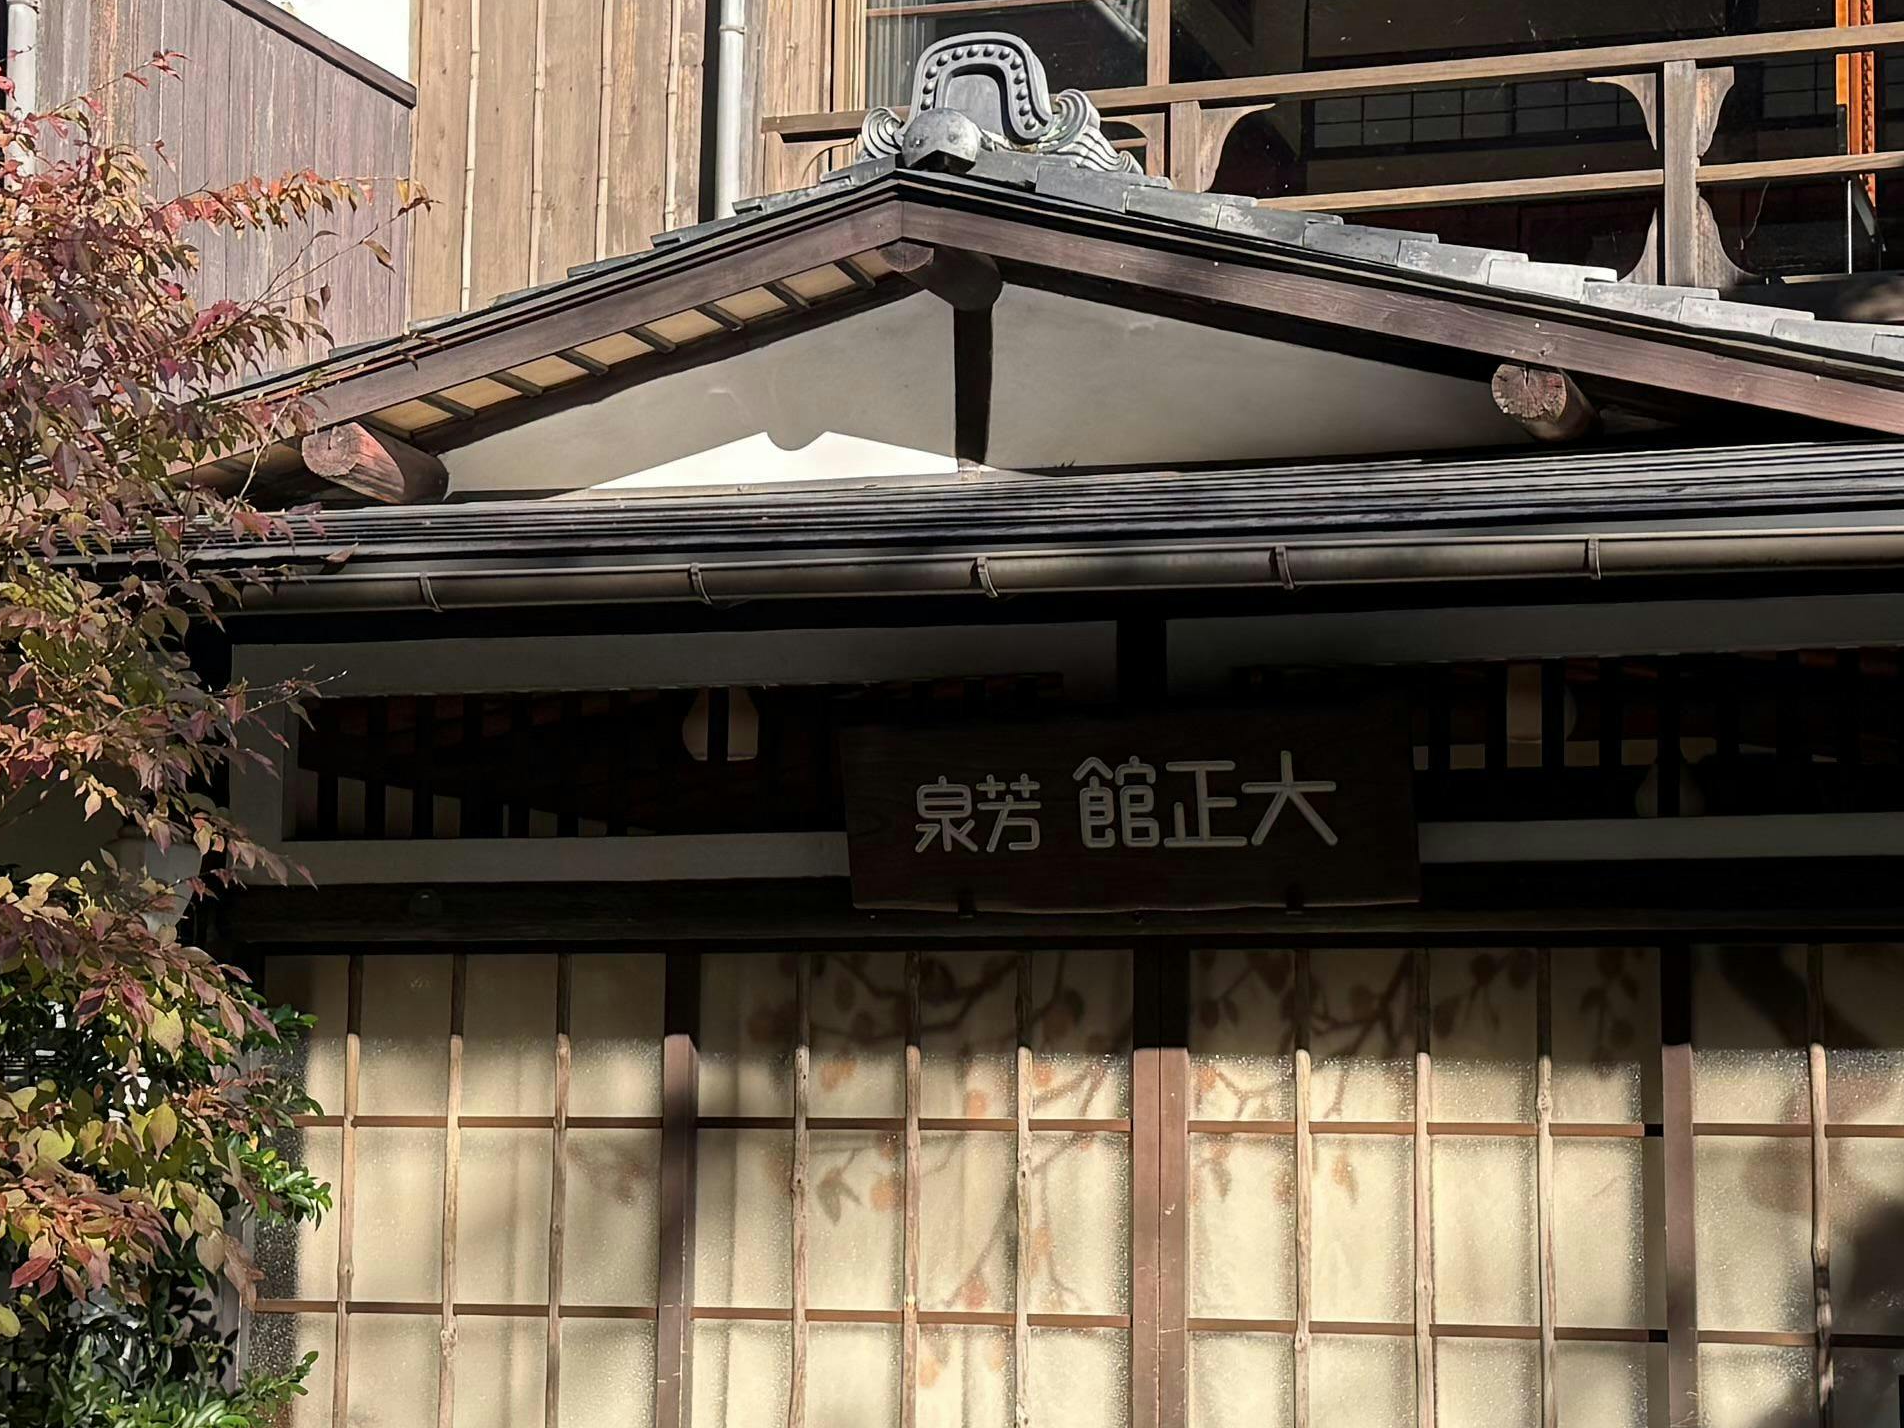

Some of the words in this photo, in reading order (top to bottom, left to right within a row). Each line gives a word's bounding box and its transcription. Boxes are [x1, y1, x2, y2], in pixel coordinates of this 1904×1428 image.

[914, 773, 1042, 853] 芳泉
[1072, 750, 1338, 849] 大正館
